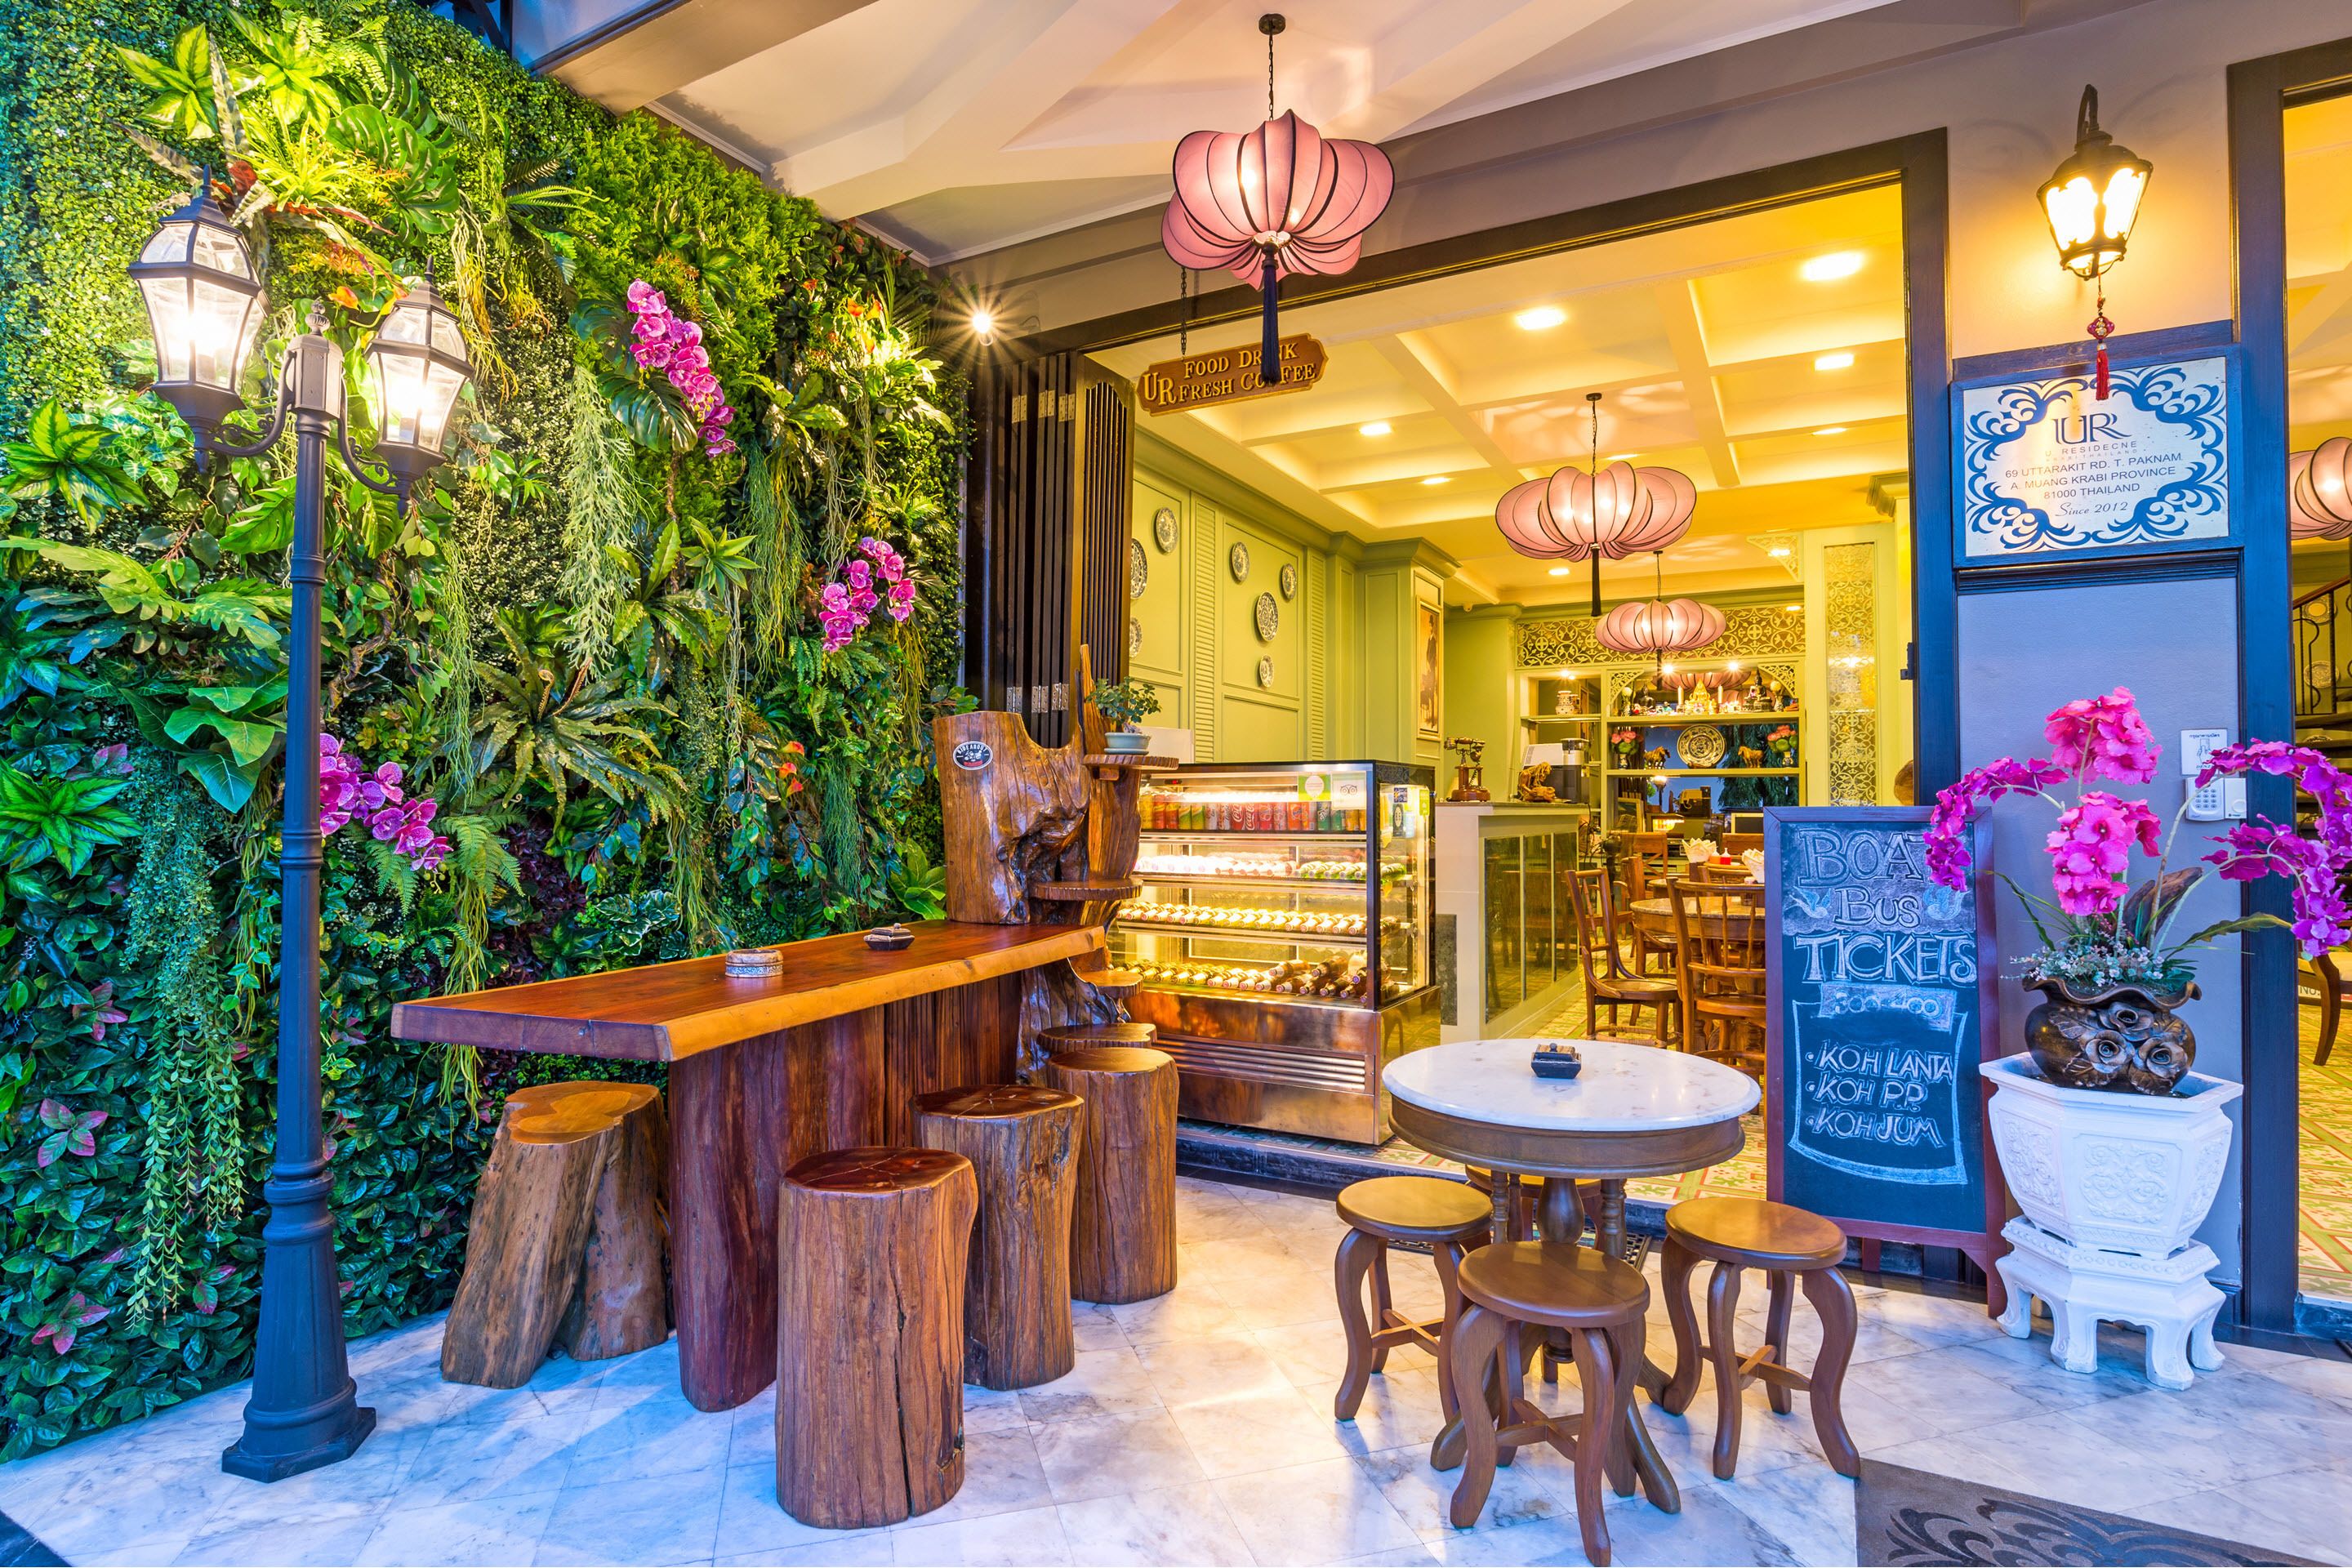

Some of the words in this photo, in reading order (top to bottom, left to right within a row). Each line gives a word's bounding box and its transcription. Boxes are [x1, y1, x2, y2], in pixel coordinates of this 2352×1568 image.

[1184, 356, 1229, 379] FOOD
[1239, 343, 1298, 368] DRK
[1143, 372, 1177, 406] UR
[1179, 378, 1234, 402] FRESH
[1241, 363, 1316, 390] COFEE
[2051, 412, 2132, 445] UR
[2061, 441, 2137, 456] RESIDECNE
[2005, 470, 2018, 479] 69
[2021, 462, 2087, 477] UTTARAKIT
[2090, 461, 2110, 470] RD.
[2025, 477, 2068, 488] MUANG
[2071, 473, 2107, 484] KRABI
[2111, 466, 2176, 481] PROVINCE
[2044, 489, 2076, 500] 81000
[2080, 483, 2140, 497] THAILAND
[2055, 501, 2090, 517] Since
[2094, 501, 2128, 514] 2012
[1794, 930, 1977, 985] TICKETS
[1815, 1040, 1881, 1076] KOH
[1884, 1049, 1953, 1085] LANTA
[1813, 1071, 1874, 1103] KOH
[1812, 1104, 1876, 1139] KOH
[1877, 1114, 1945, 1147] JUM
